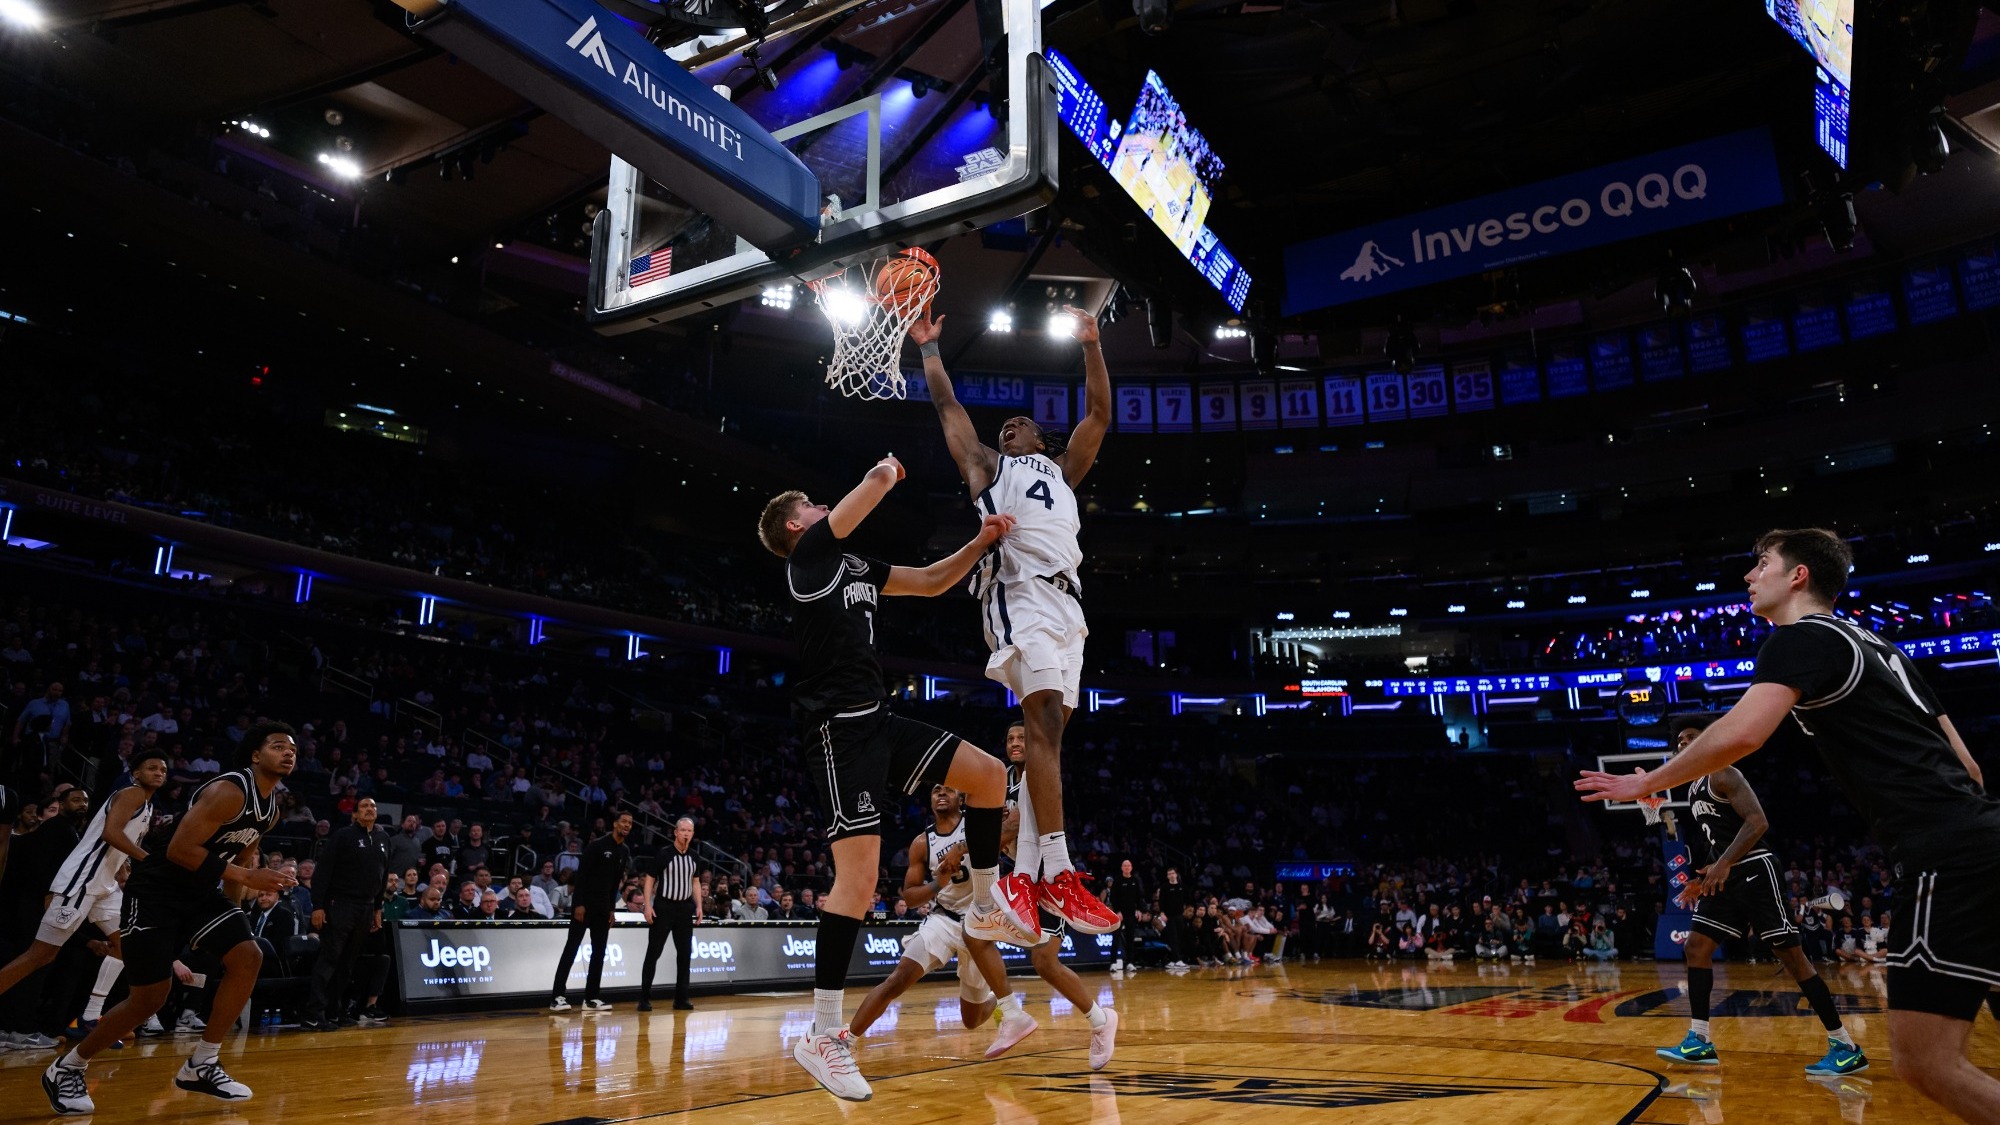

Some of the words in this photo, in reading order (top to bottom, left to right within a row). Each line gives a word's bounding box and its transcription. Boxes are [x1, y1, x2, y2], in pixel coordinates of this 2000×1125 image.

[623, 61, 744, 161] AlumniFi
[1411, 198, 1591, 265] Invesco
[1600, 163, 1708, 217] QQQ
[1964, 268, 2000, 286] 1991-9
[964, 387, 983, 399] JOEL
[986, 377, 1025, 401] 150
[1372, 384, 1400, 410] 19
[1411, 380, 1444, 406] 30
[1456, 373, 1490, 400] 35
[1046, 397, 1056, 421] 1
[1127, 398, 1142, 421] 3
[1166, 398, 1181, 421] 7
[1210, 397, 1224, 420] 9
[1252, 394, 1266, 418] 9
[1288, 392, 1311, 416] 11
[1332, 389, 1356, 415] 11
[1026, 479, 1054, 510] 4
[35, 493, 81, 513] SUITE
[83, 504, 128, 524] LEVEL
[1907, 554, 1930, 564] Jeep
[1985, 543, 2000, 552] Jee
[843, 581, 878, 612] PROVIDEN
[1631, 589, 1649, 598] Jeep
[1696, 582, 1715, 591] Jeep
[1448, 605, 1465, 613] Jeep
[1507, 600, 1525, 609] Jeep
[1568, 595, 1586, 604] Jeep
[1333, 611, 1350, 619] Jeep
[1390, 608, 1407, 617] Jeep
[864, 610, 874, 645] 7
[1961, 642, 1980, 650] 41.7
[1578, 672, 1622, 684] BUTLER
[1675, 666, 1692, 677] 42
[1705, 667, 1725, 677] 5.2
[1736, 661, 1754, 671] 40
[1629, 690, 1650, 703] 5.0
[1701, 823, 1716, 846] 2
[873, 912, 887, 920] POSS
[691, 936, 733, 963] Jeep
[864, 933, 900, 957] Jeep
[1095, 934, 1113, 947] Jee
[420, 939, 491, 972] Jeep
